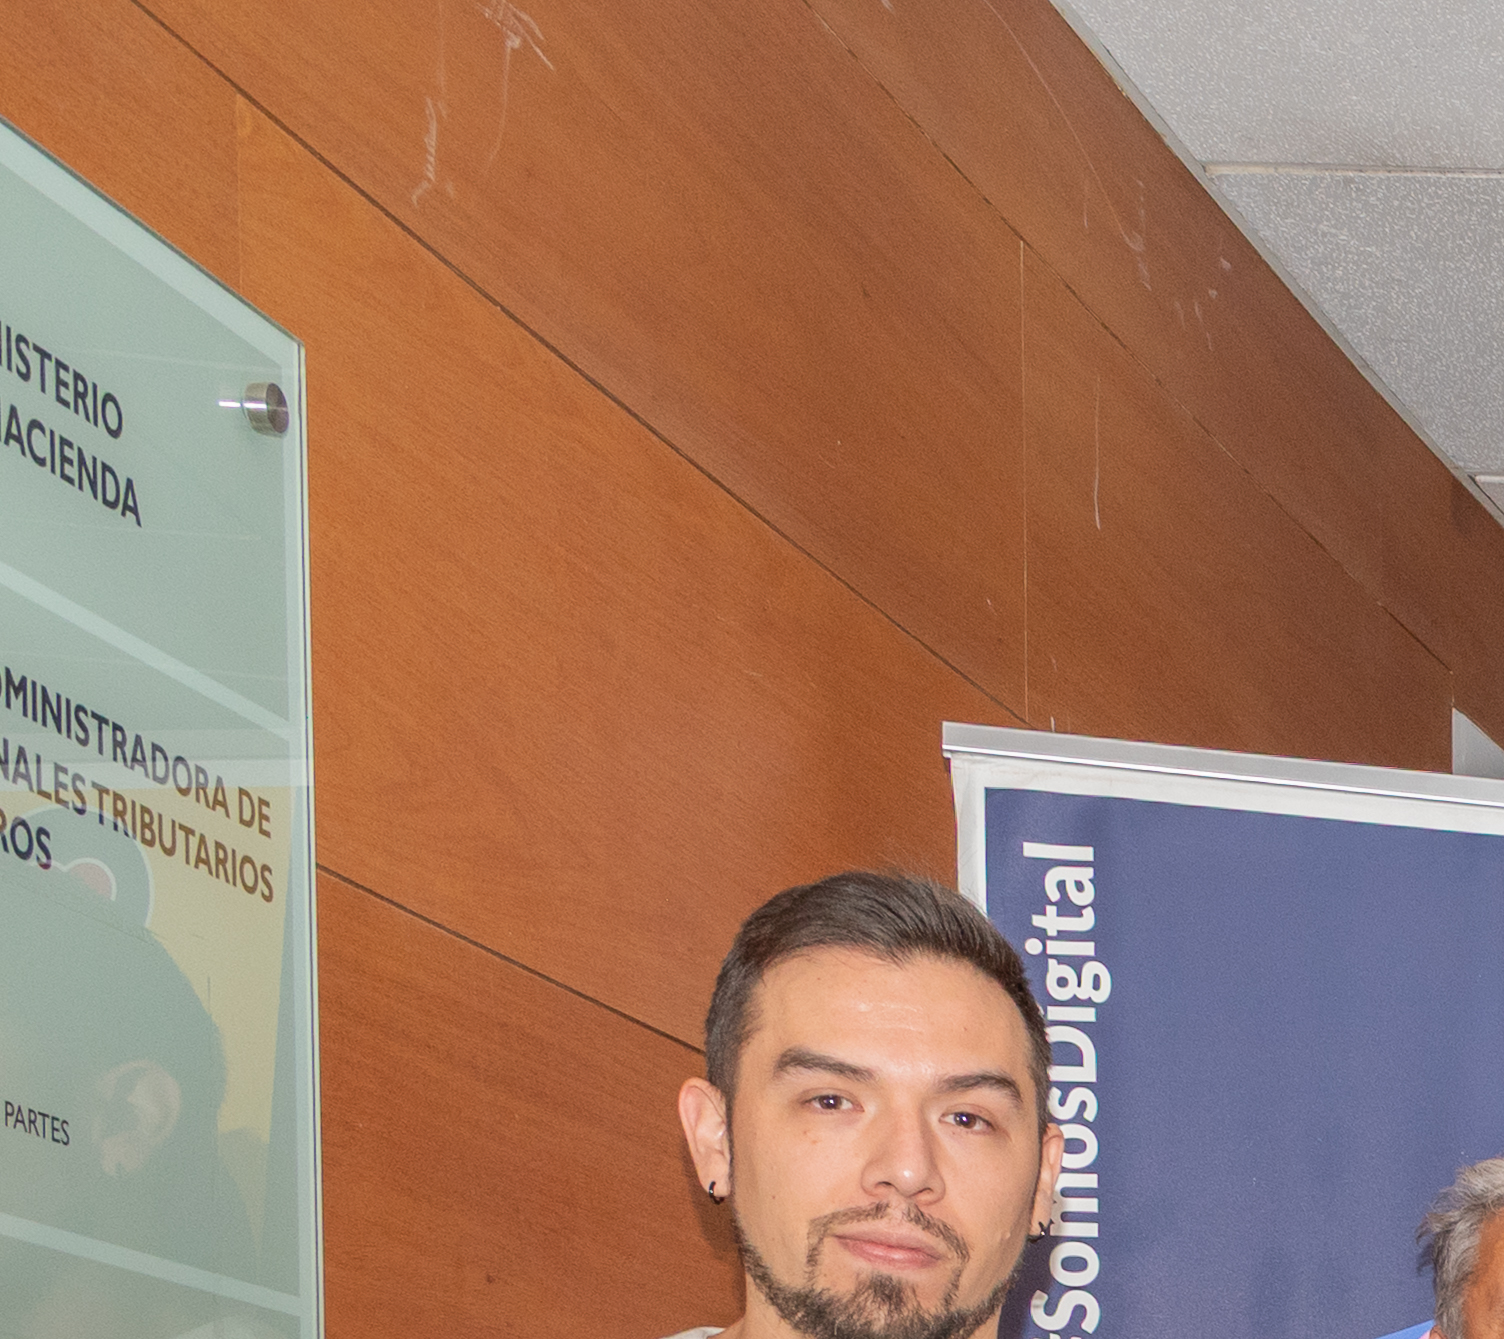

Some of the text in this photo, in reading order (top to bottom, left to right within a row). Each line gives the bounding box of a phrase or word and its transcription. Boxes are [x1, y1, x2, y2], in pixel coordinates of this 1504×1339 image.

[0, 320, 123, 440] ISTERIO
[0, 404, 142, 528] ACIENDA
[0, 666, 272, 839] MINISTRADORA DE
[91, 780, 274, 903] TRIBUTARIOS
[5, 1101, 70, 1146] PARTES
